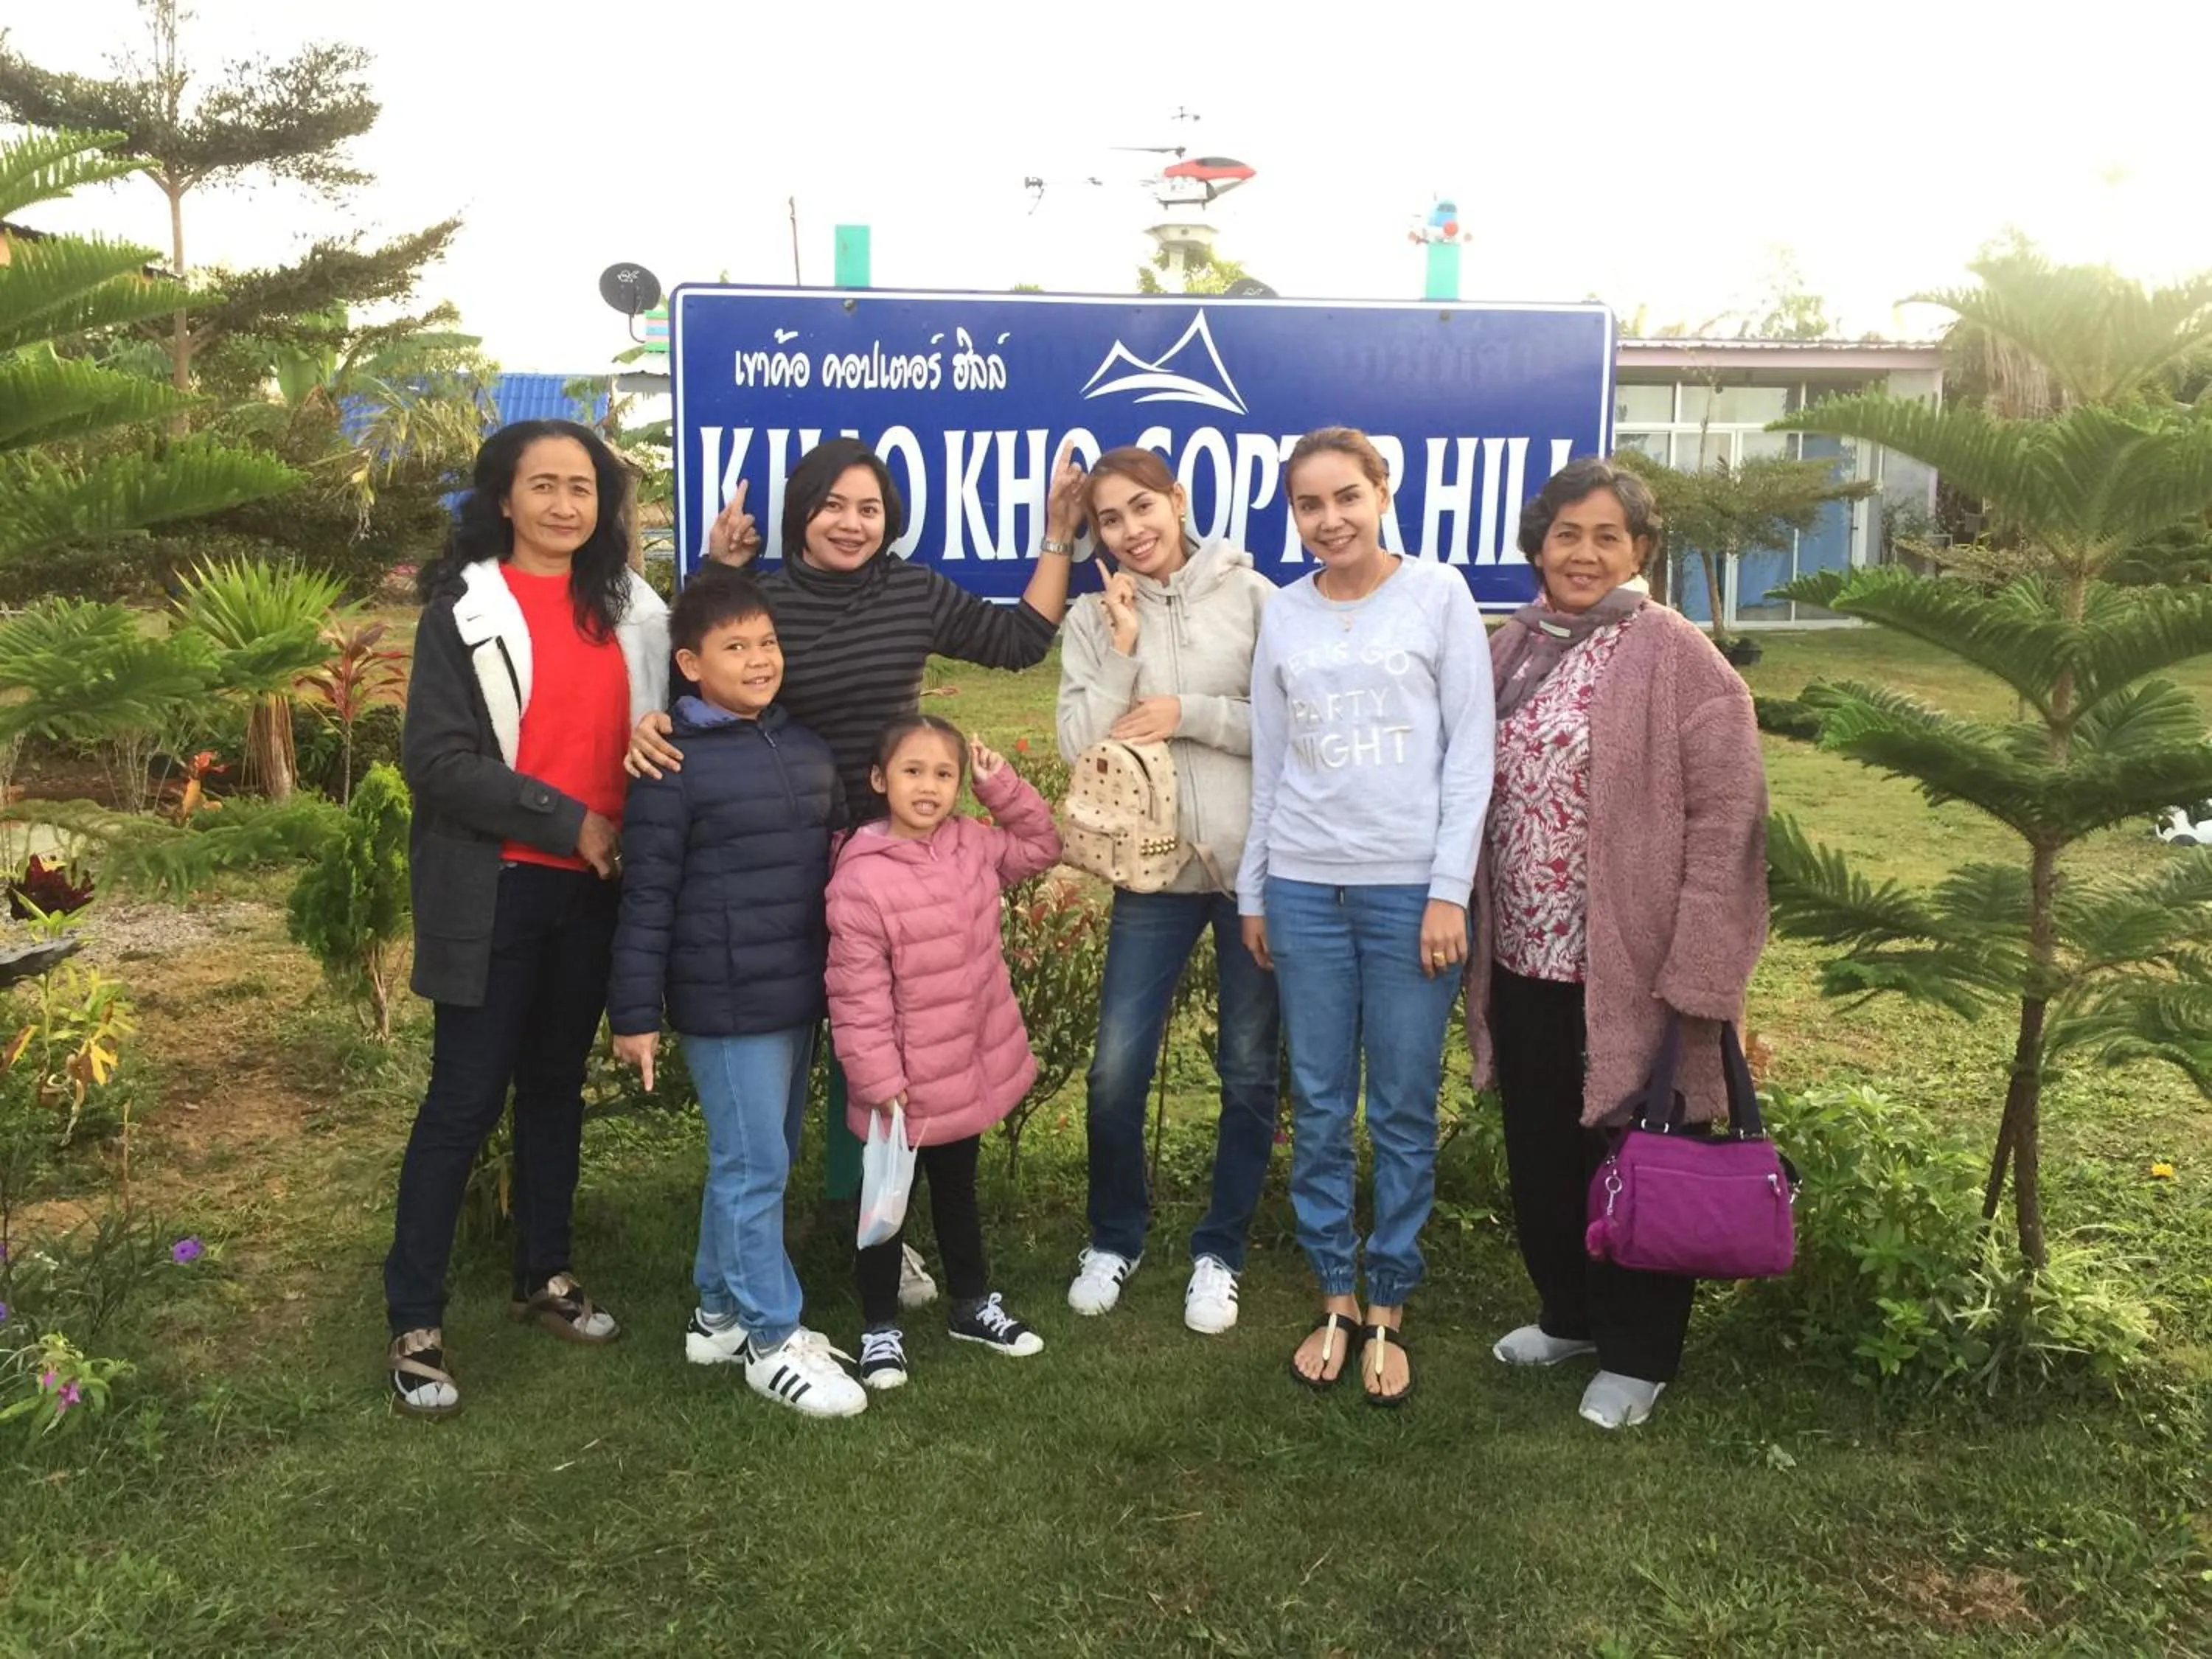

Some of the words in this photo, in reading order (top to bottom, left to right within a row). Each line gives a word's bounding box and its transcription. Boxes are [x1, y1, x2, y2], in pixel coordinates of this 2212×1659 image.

[735, 328, 810, 388] เขาค้อ
[822, 333, 945, 389] คอปเตอร์
[952, 327, 1011, 390] ฮิลล์
[699, 425, 928, 561] KHO
